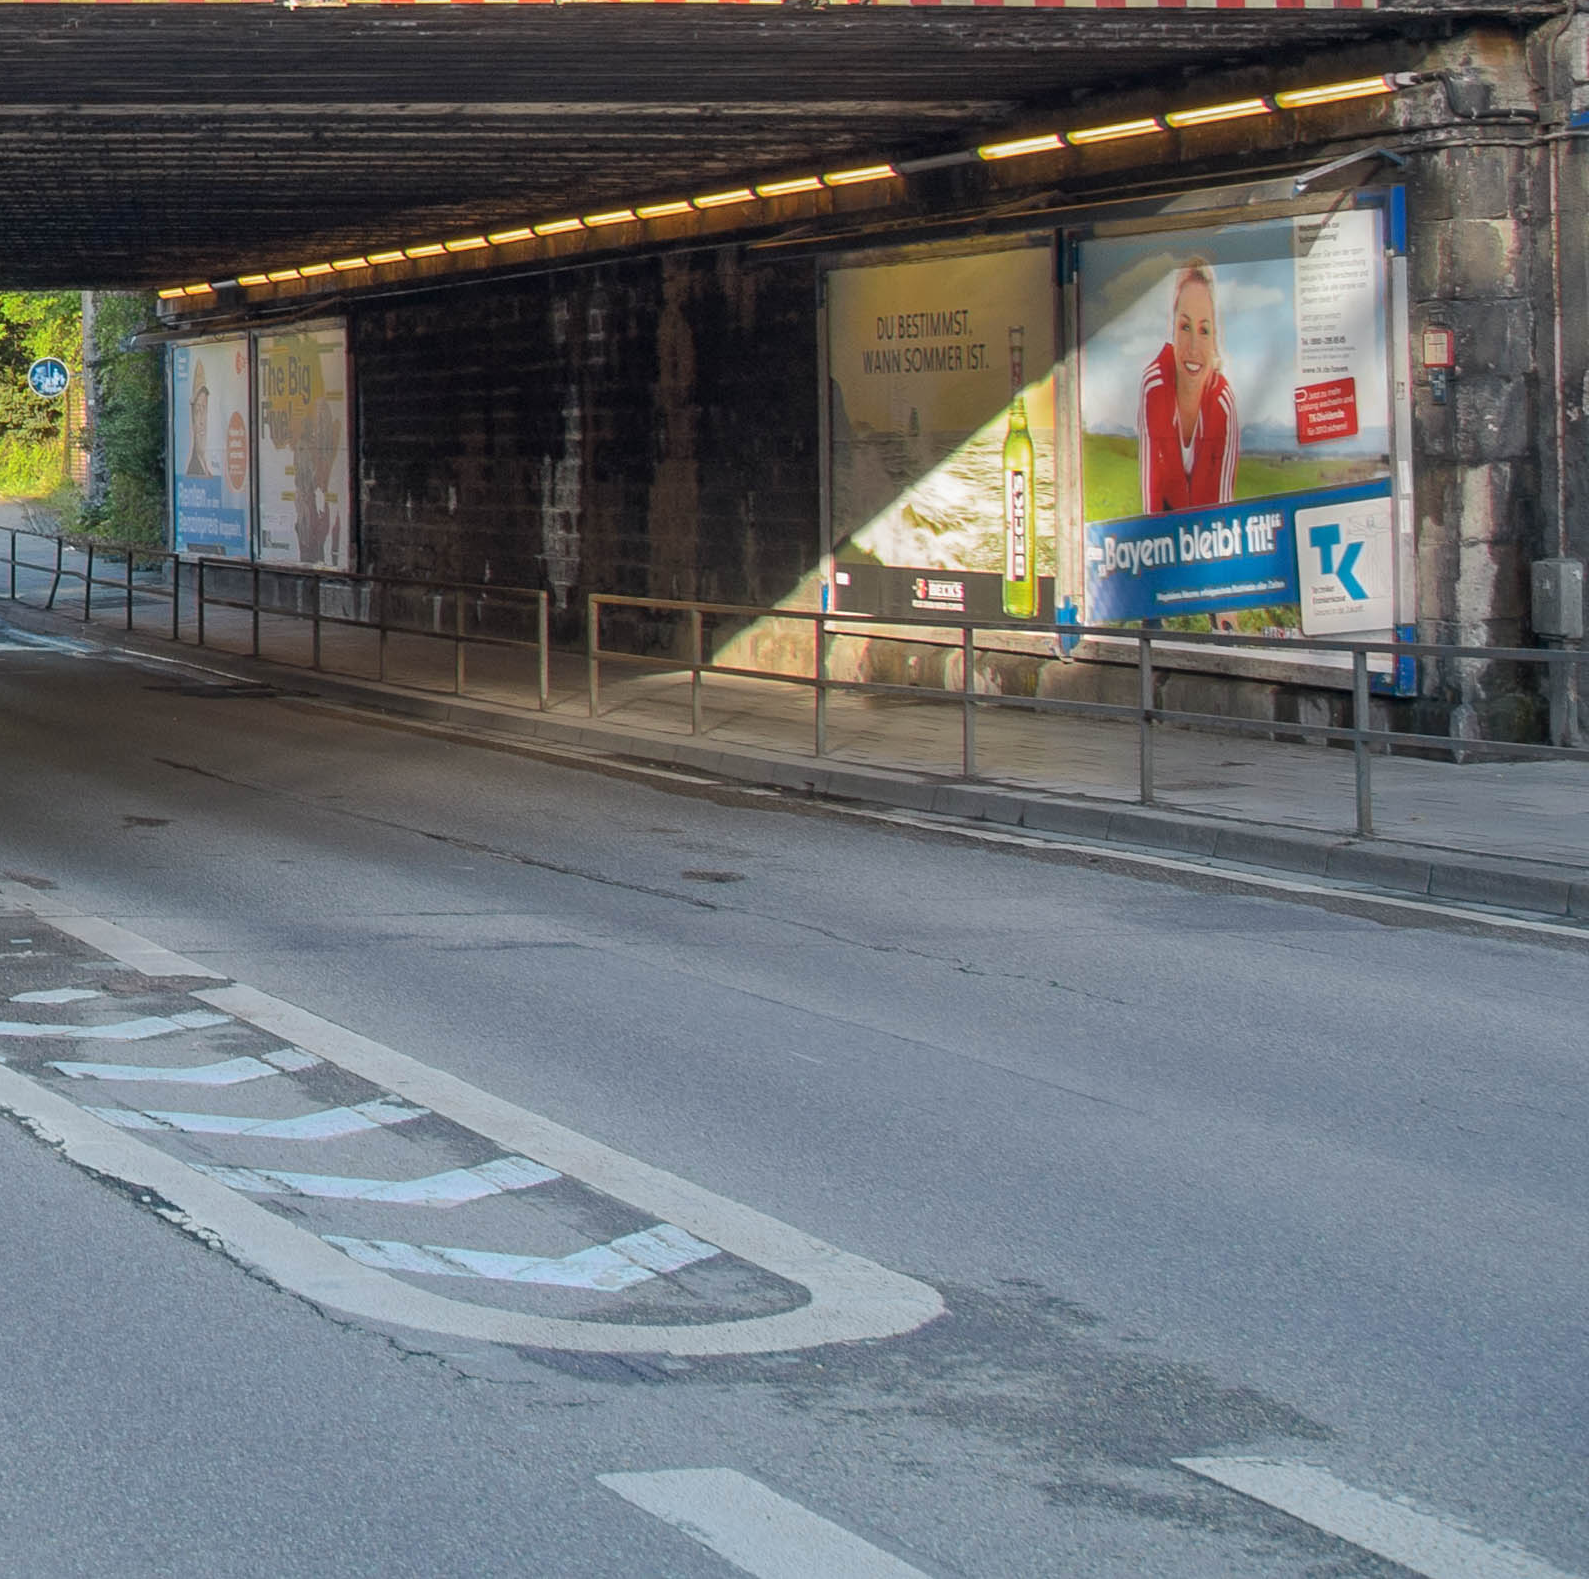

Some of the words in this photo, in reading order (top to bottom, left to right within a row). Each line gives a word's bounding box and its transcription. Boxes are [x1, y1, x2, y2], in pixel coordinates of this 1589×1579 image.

[876, 315, 895, 340] DU
[259, 357, 286, 397] The
[288, 356, 311, 406] Big
[862, 347, 902, 374] WANN
[904, 344, 962, 373] SOMMER
[965, 342, 990, 371] IST.
[1178, 516, 1242, 563] bleibt
[1309, 524, 1369, 601] TK
